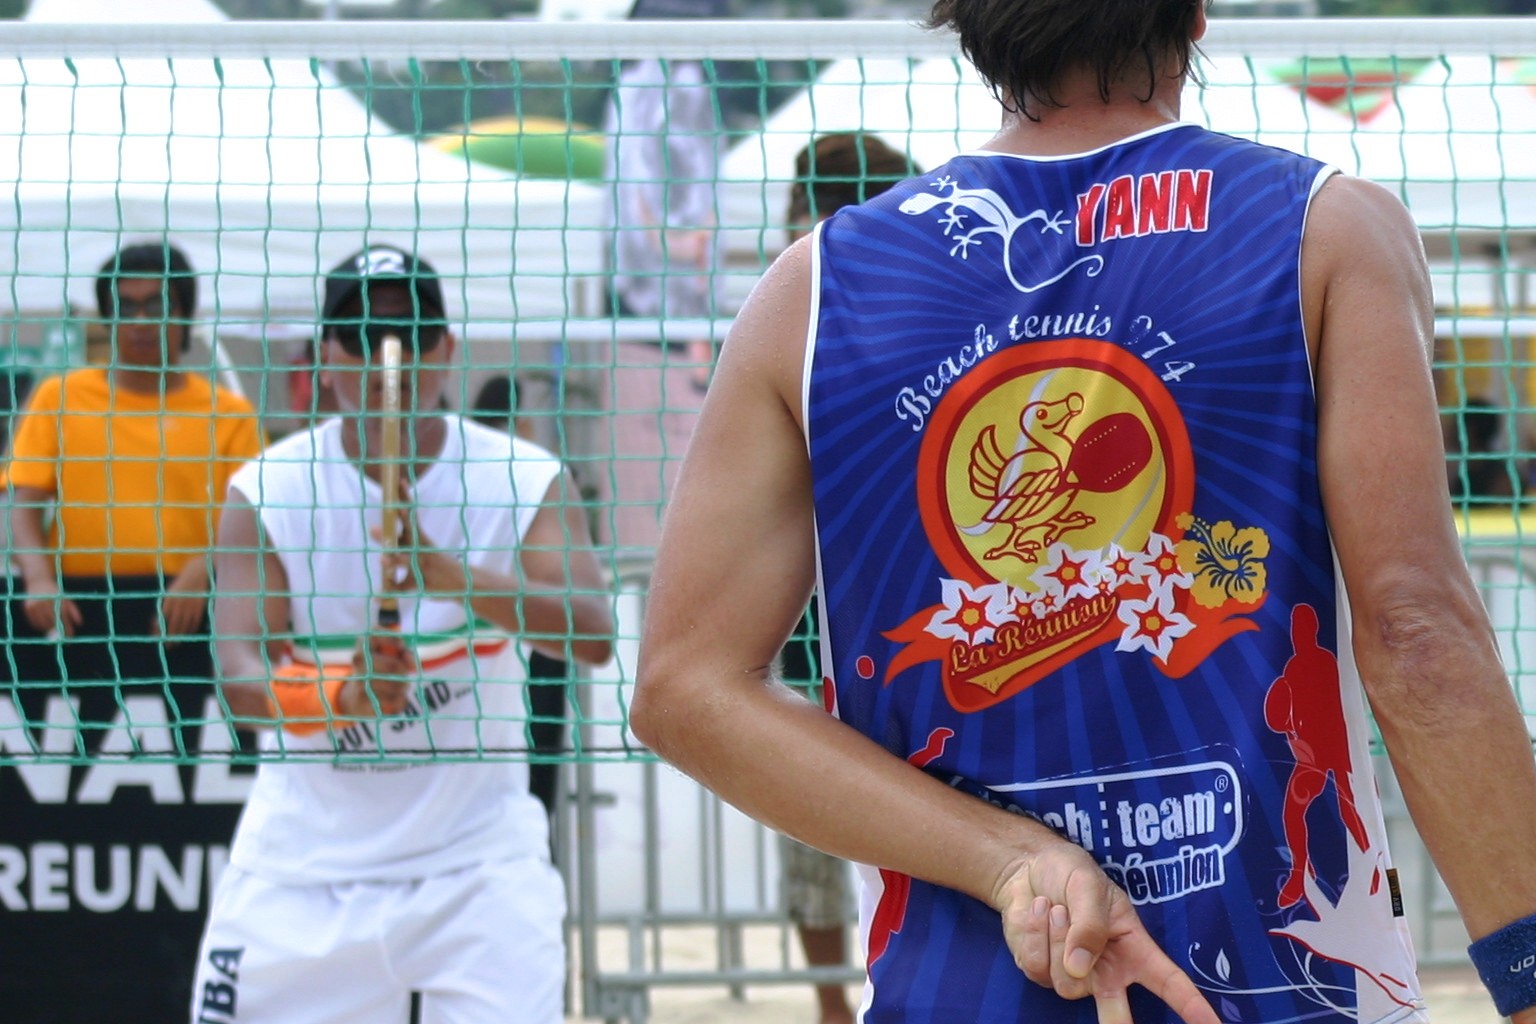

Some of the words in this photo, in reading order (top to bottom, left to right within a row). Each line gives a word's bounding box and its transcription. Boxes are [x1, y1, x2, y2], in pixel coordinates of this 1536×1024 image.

[1076, 169, 1213, 247] YANN
[895, 323, 999, 432] Beach
[1008, 304, 1112, 341] tennis
[950, 643, 990, 677] La
[996, 595, 1118, 658] Réunion
[1117, 789, 1216, 848] team
